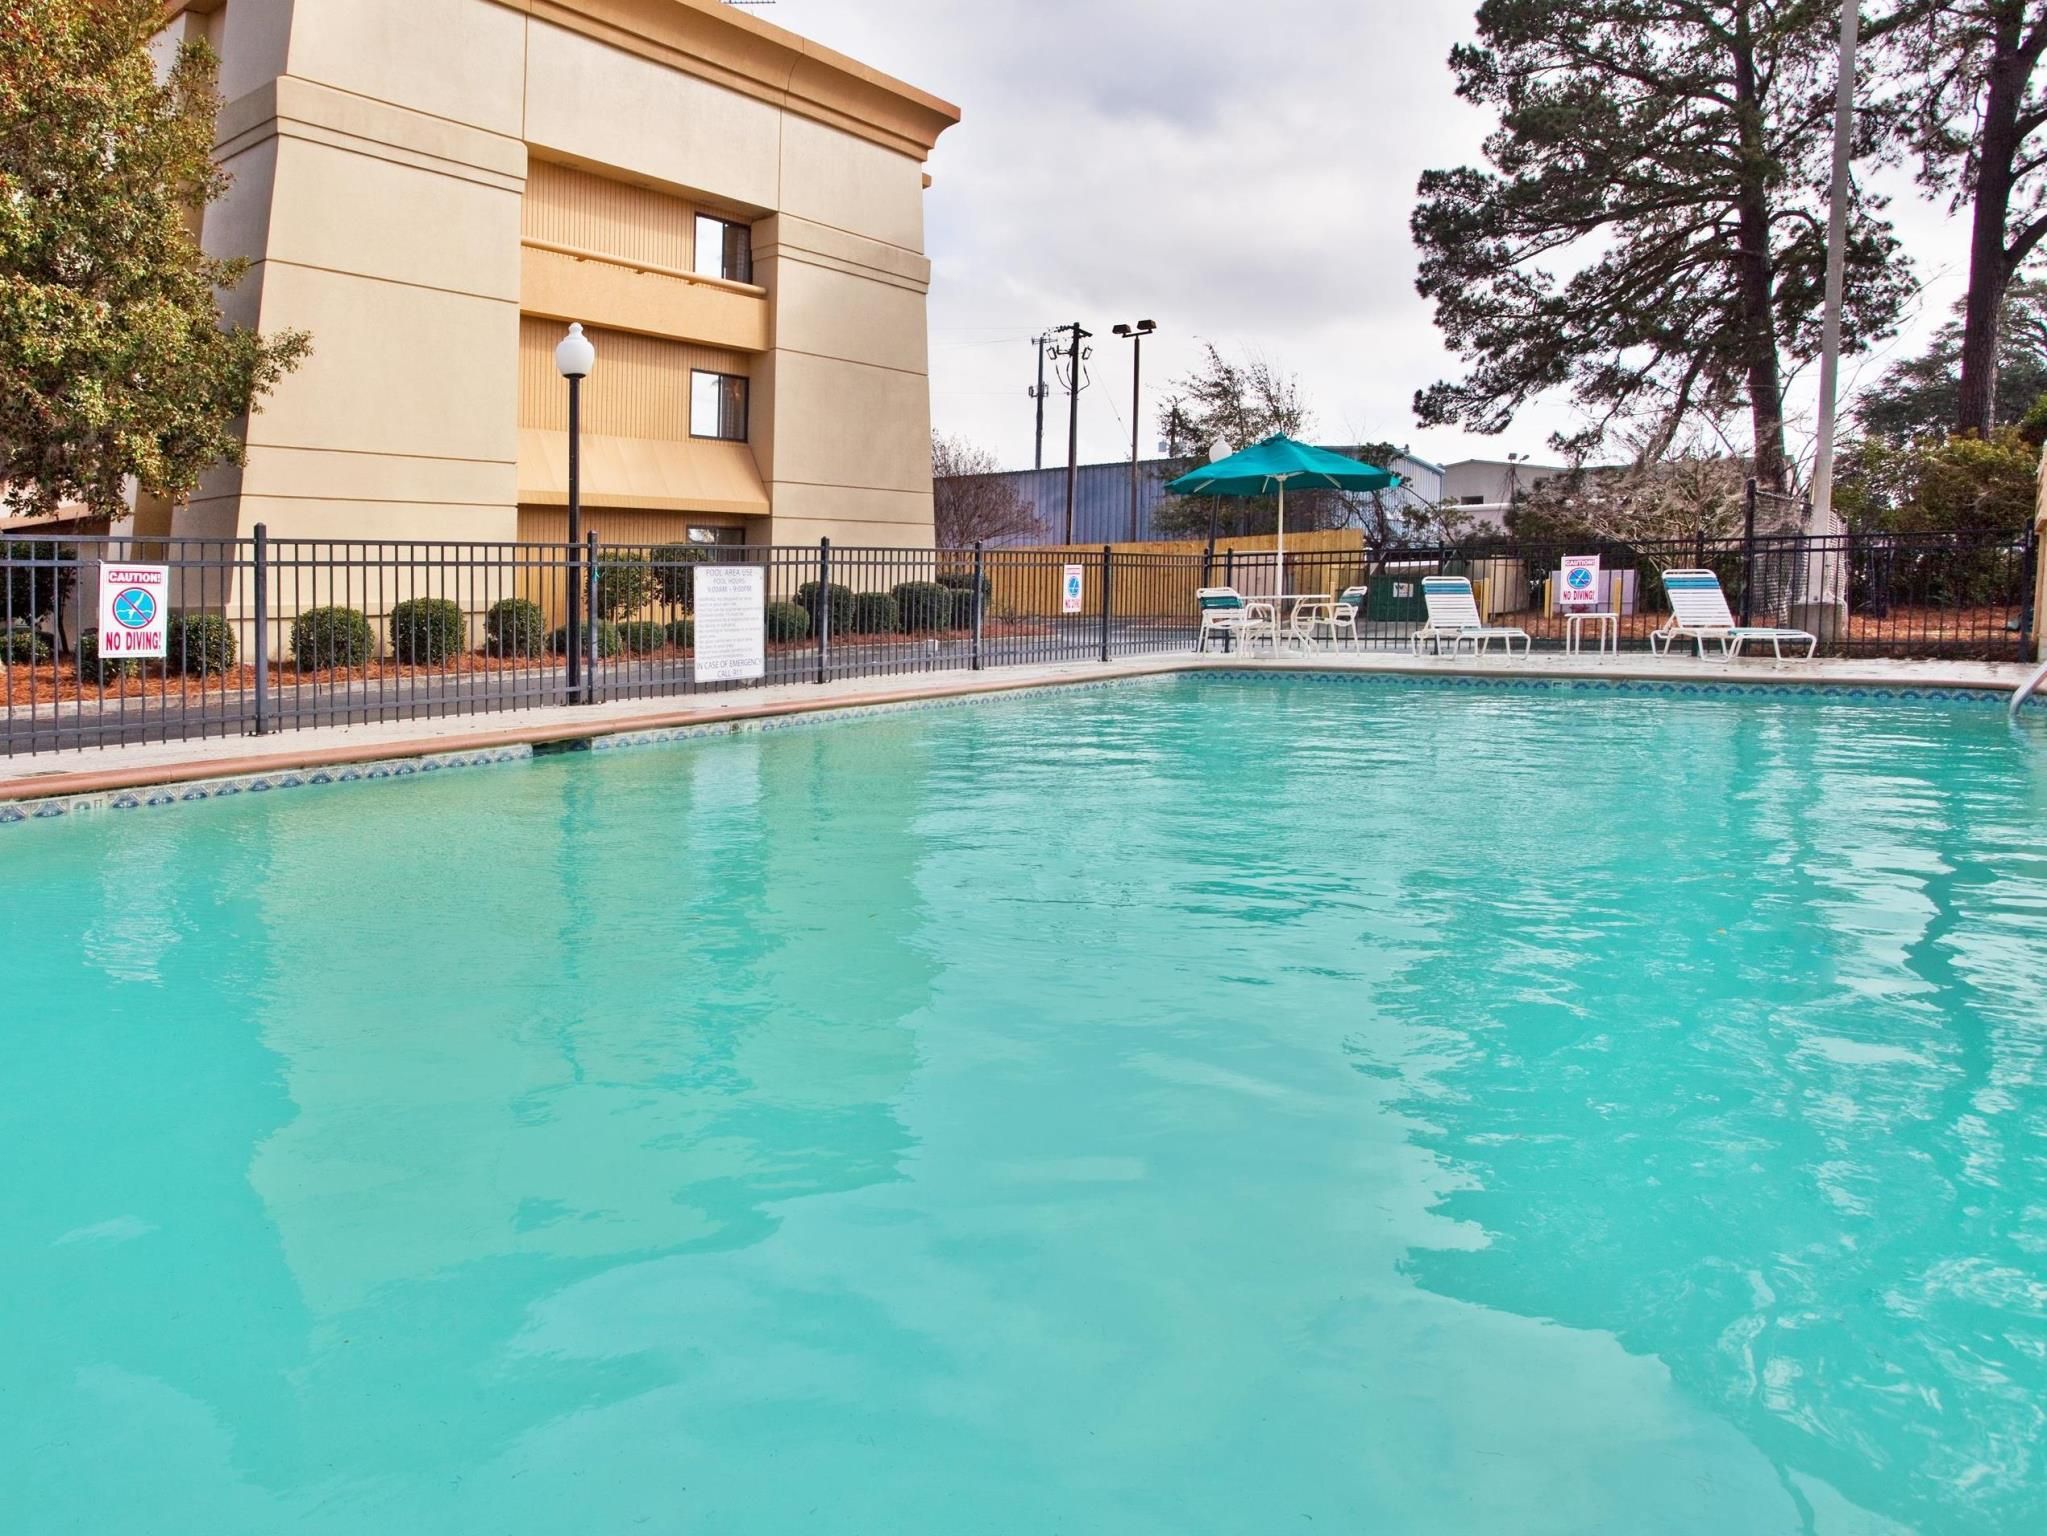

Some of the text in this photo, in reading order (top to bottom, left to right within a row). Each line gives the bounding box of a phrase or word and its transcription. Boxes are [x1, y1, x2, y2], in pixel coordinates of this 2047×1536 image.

[109, 571, 161, 584] CAUTION!
[706, 568, 722, 577] POOL
[724, 568, 741, 577] AREA
[1563, 591, 1571, 600] NO
[106, 631, 162, 651] NO DIVING!
[704, 660, 719, 670] CASE
[720, 659, 728, 668] OF
